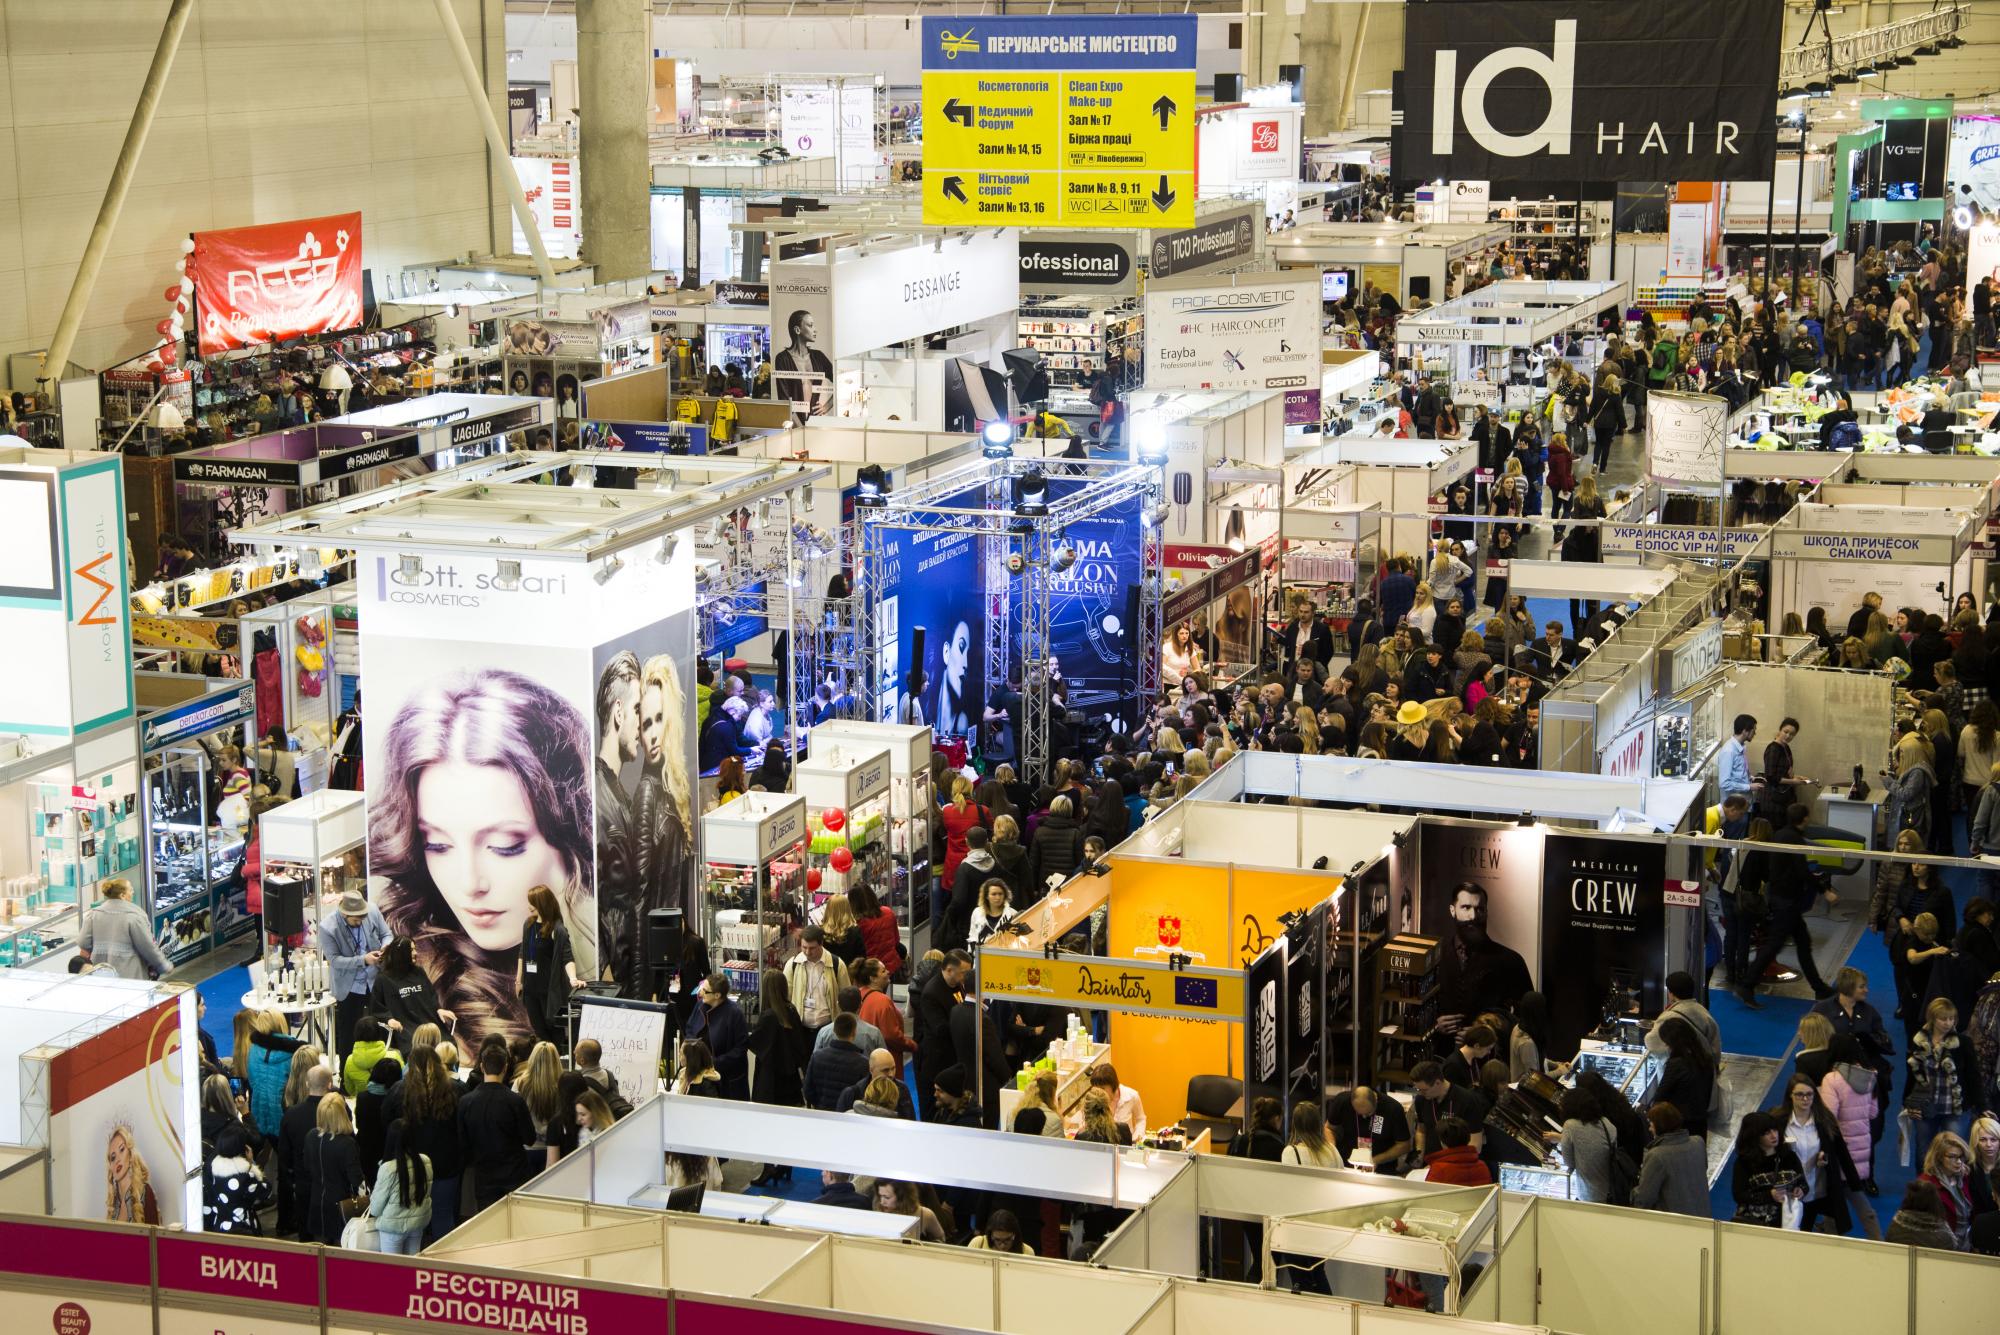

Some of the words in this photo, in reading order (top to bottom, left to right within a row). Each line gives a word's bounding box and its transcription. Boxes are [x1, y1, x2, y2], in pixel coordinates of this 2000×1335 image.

[987, 35, 1087, 54] ПЕРУКАРСЬКЕ
[1089, 35, 1177, 55] МИСТЕЦТВО
[978, 80, 1049, 92] Косметологія
[1069, 80, 1098, 92] Clean
[1100, 80, 1123, 93] Expo
[1069, 96, 1112, 108] Make-up
[978, 105, 1033, 117] Медичний
[1069, 114, 1089, 126] Зал
[1091, 115, 1101, 126] №
[1102, 115, 1112, 126] 17
[1069, 133, 1100, 145] Біржа
[1102, 133, 1132, 146] праці
[1597, 120, 1740, 154] HAIR
[978, 143, 1004, 155] Зали
[1006, 144, 1017, 155] №
[1018, 143, 1029, 157] 14,
[1031, 143, 1042, 155] 15
[1886, 145, 1904, 156] VG
[1096, 154, 1144, 163] Лівобережна
[978, 172, 1030, 185] Нігтьовий
[1069, 182, 1095, 194] Зали
[1096, 183, 1108, 194] №
[1109, 183, 1119, 195] 8,
[1120, 183, 1130, 195] 9,
[1131, 183, 1141, 194] 11
[978, 202, 1004, 213] Зали
[1006, 202, 1017, 213] №
[1018, 202, 1031, 215] 13,
[1033, 202, 1045, 213] 16
[1070, 200, 1091, 212] WC
[1172, 236, 1191, 260] TICO
[1192, 224, 1236, 256] Professional
[904, 270, 961, 303] DESSANGE
[1172, 289, 1295, 309] PROF-COSMETIC
[1211, 317, 1286, 333] HAIRCONCEPT
[1418, 327, 1471, 341] SELECTIVE
[1160, 347, 1196, 362] Erayba
[1160, 360, 1197, 370] Professional
[453, 420, 492, 443] JAGUAR
[355, 447, 390, 468] FARMAGAN
[205, 464, 267, 481] FARMAGAN
[1614, 527, 1695, 541] УКРАИНСКАЯ
[1635, 540, 1679, 552] ВОЛОС
[1682, 542, 1703, 552] VIP
[1803, 535, 1848, 548] ШКОЛА
[1852, 536, 1920, 550] ПРИЧЁСОК
[1829, 548, 1893, 560] CHAIKOVA
[390, 591, 480, 607] COSMETICS
[179, 704, 225, 730] perukar.com
[1460, 846, 1501, 870] CREW
[1572, 859, 1638, 873] AMERICAN
[1571, 878, 1637, 916] CREW
[1571, 920, 1591, 928] Official
[1592, 922, 1615, 931] Supplier
[1390, 955, 1411, 970] CREW
[984, 980, 1013, 991] 2A-3-5
[200, 1255, 278, 1289] ВИХІД
[415, 1270, 580, 1310] РЕЄСТРАЦІЯ
[61, 1308, 80, 1317] ESTET
[406, 1294, 589, 1335] ДОПОВІДАЧІВ
[61, 1317, 87, 1328] BEAUTY
[61, 1327, 80, 1335] EXPO
